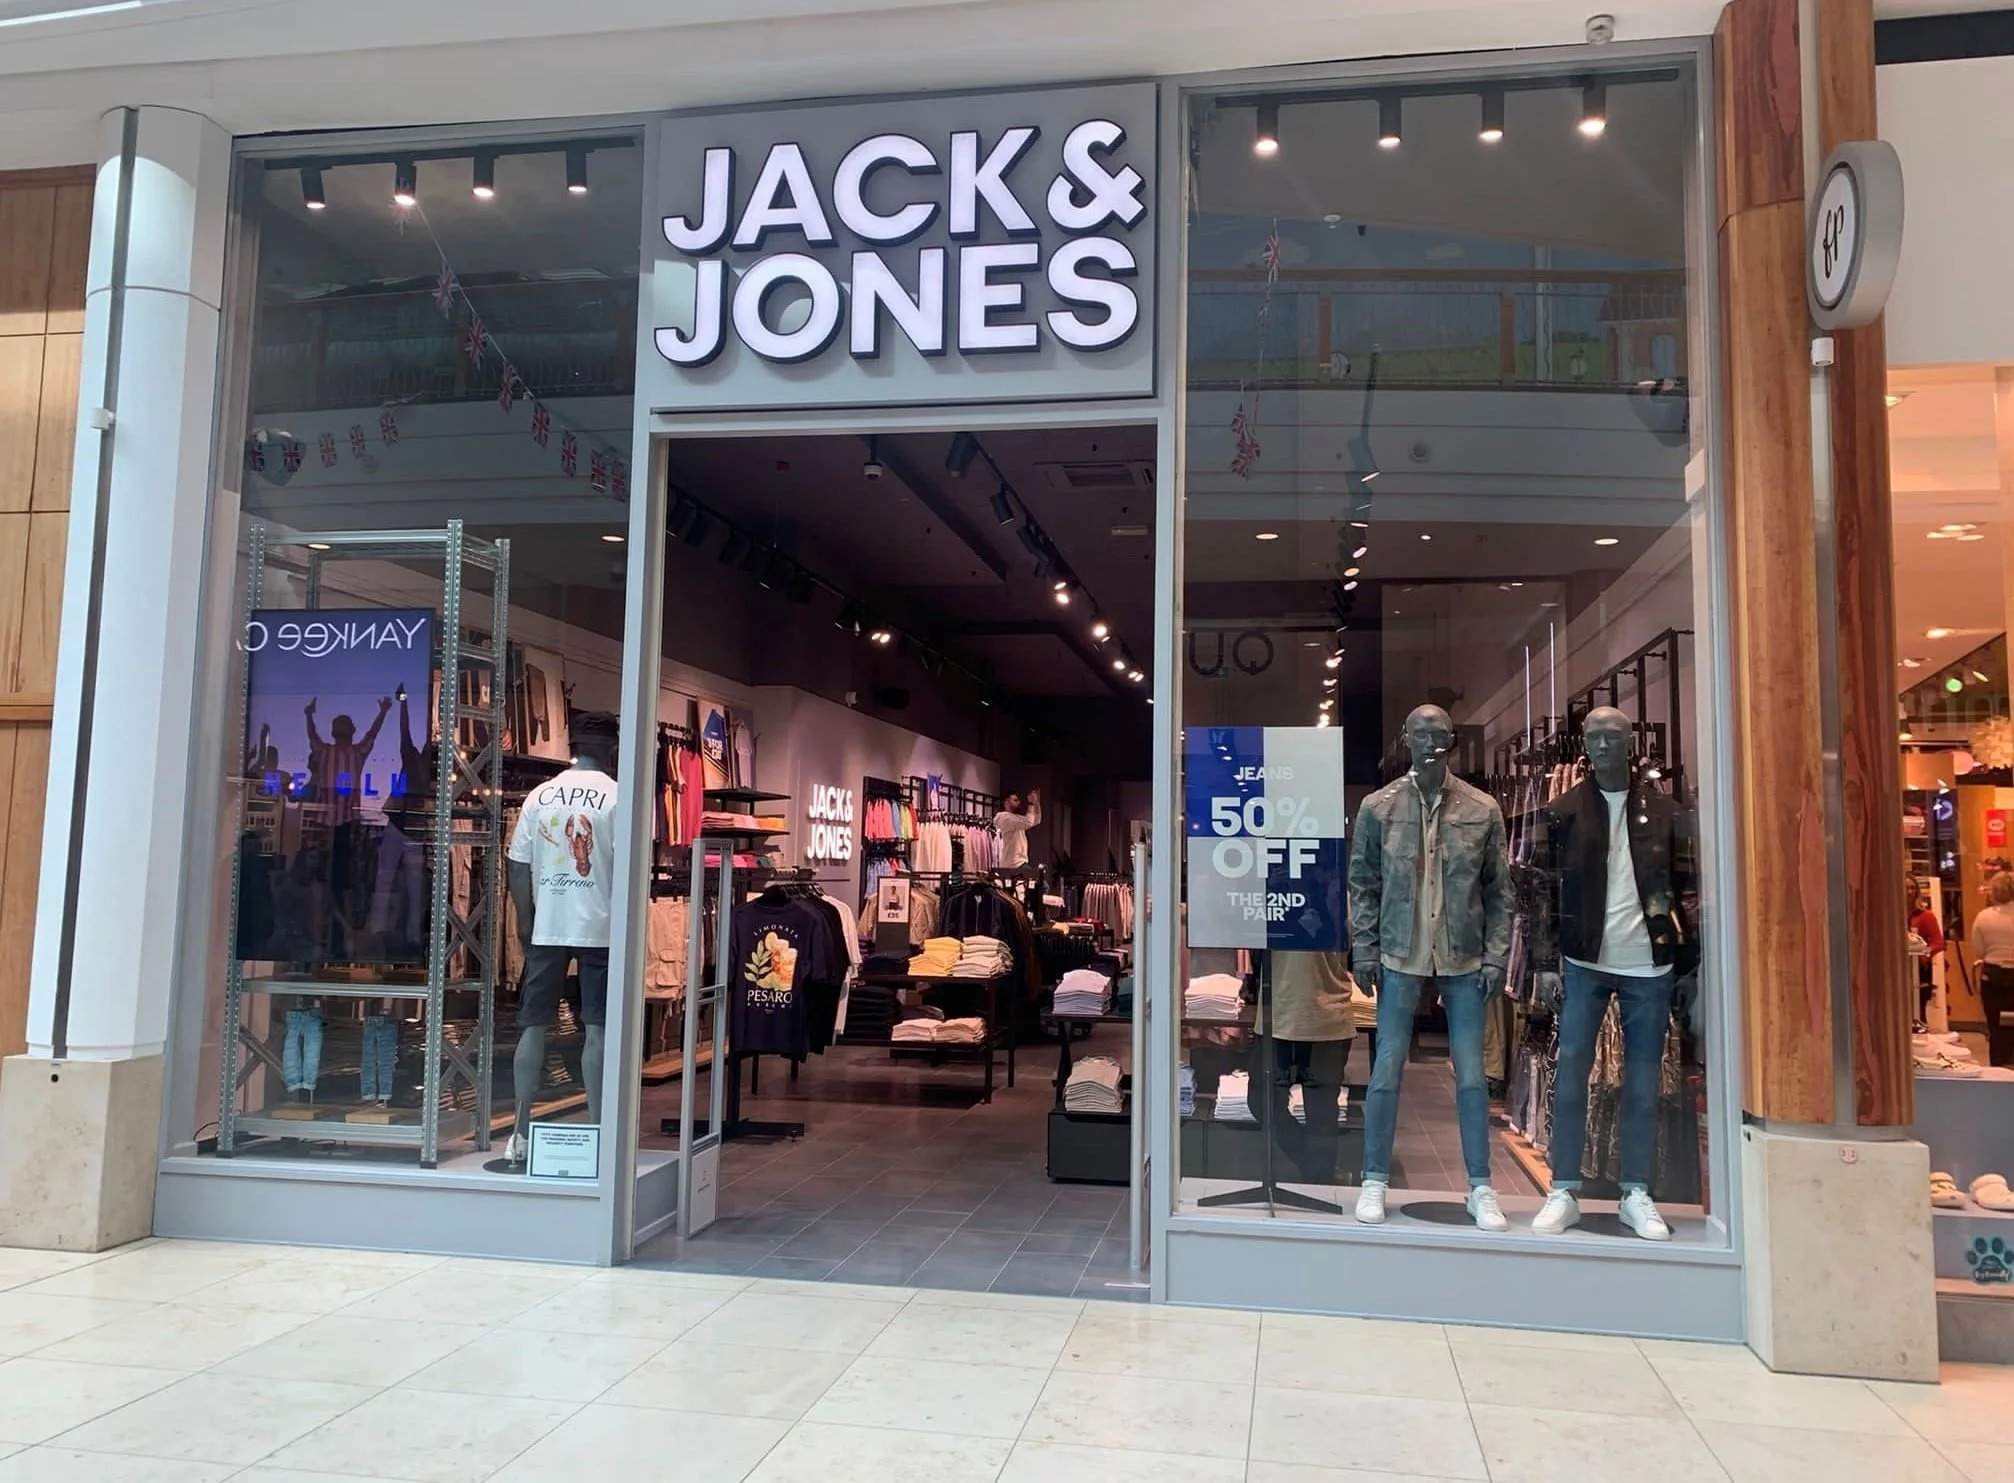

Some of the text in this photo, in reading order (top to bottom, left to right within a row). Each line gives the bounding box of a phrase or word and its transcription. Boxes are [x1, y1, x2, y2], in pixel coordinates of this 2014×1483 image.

[654, 236, 1139, 366] JONES
[1236, 766, 1295, 781] JEANS
[538, 786, 606, 810] CAPRI
[1211, 796, 1320, 837] 50%
[807, 823, 852, 860] JONES
[1212, 838, 1320, 879] OFF
[1226, 892, 1306, 908] THE 2ND
[747, 989, 792, 1004] PESARO
